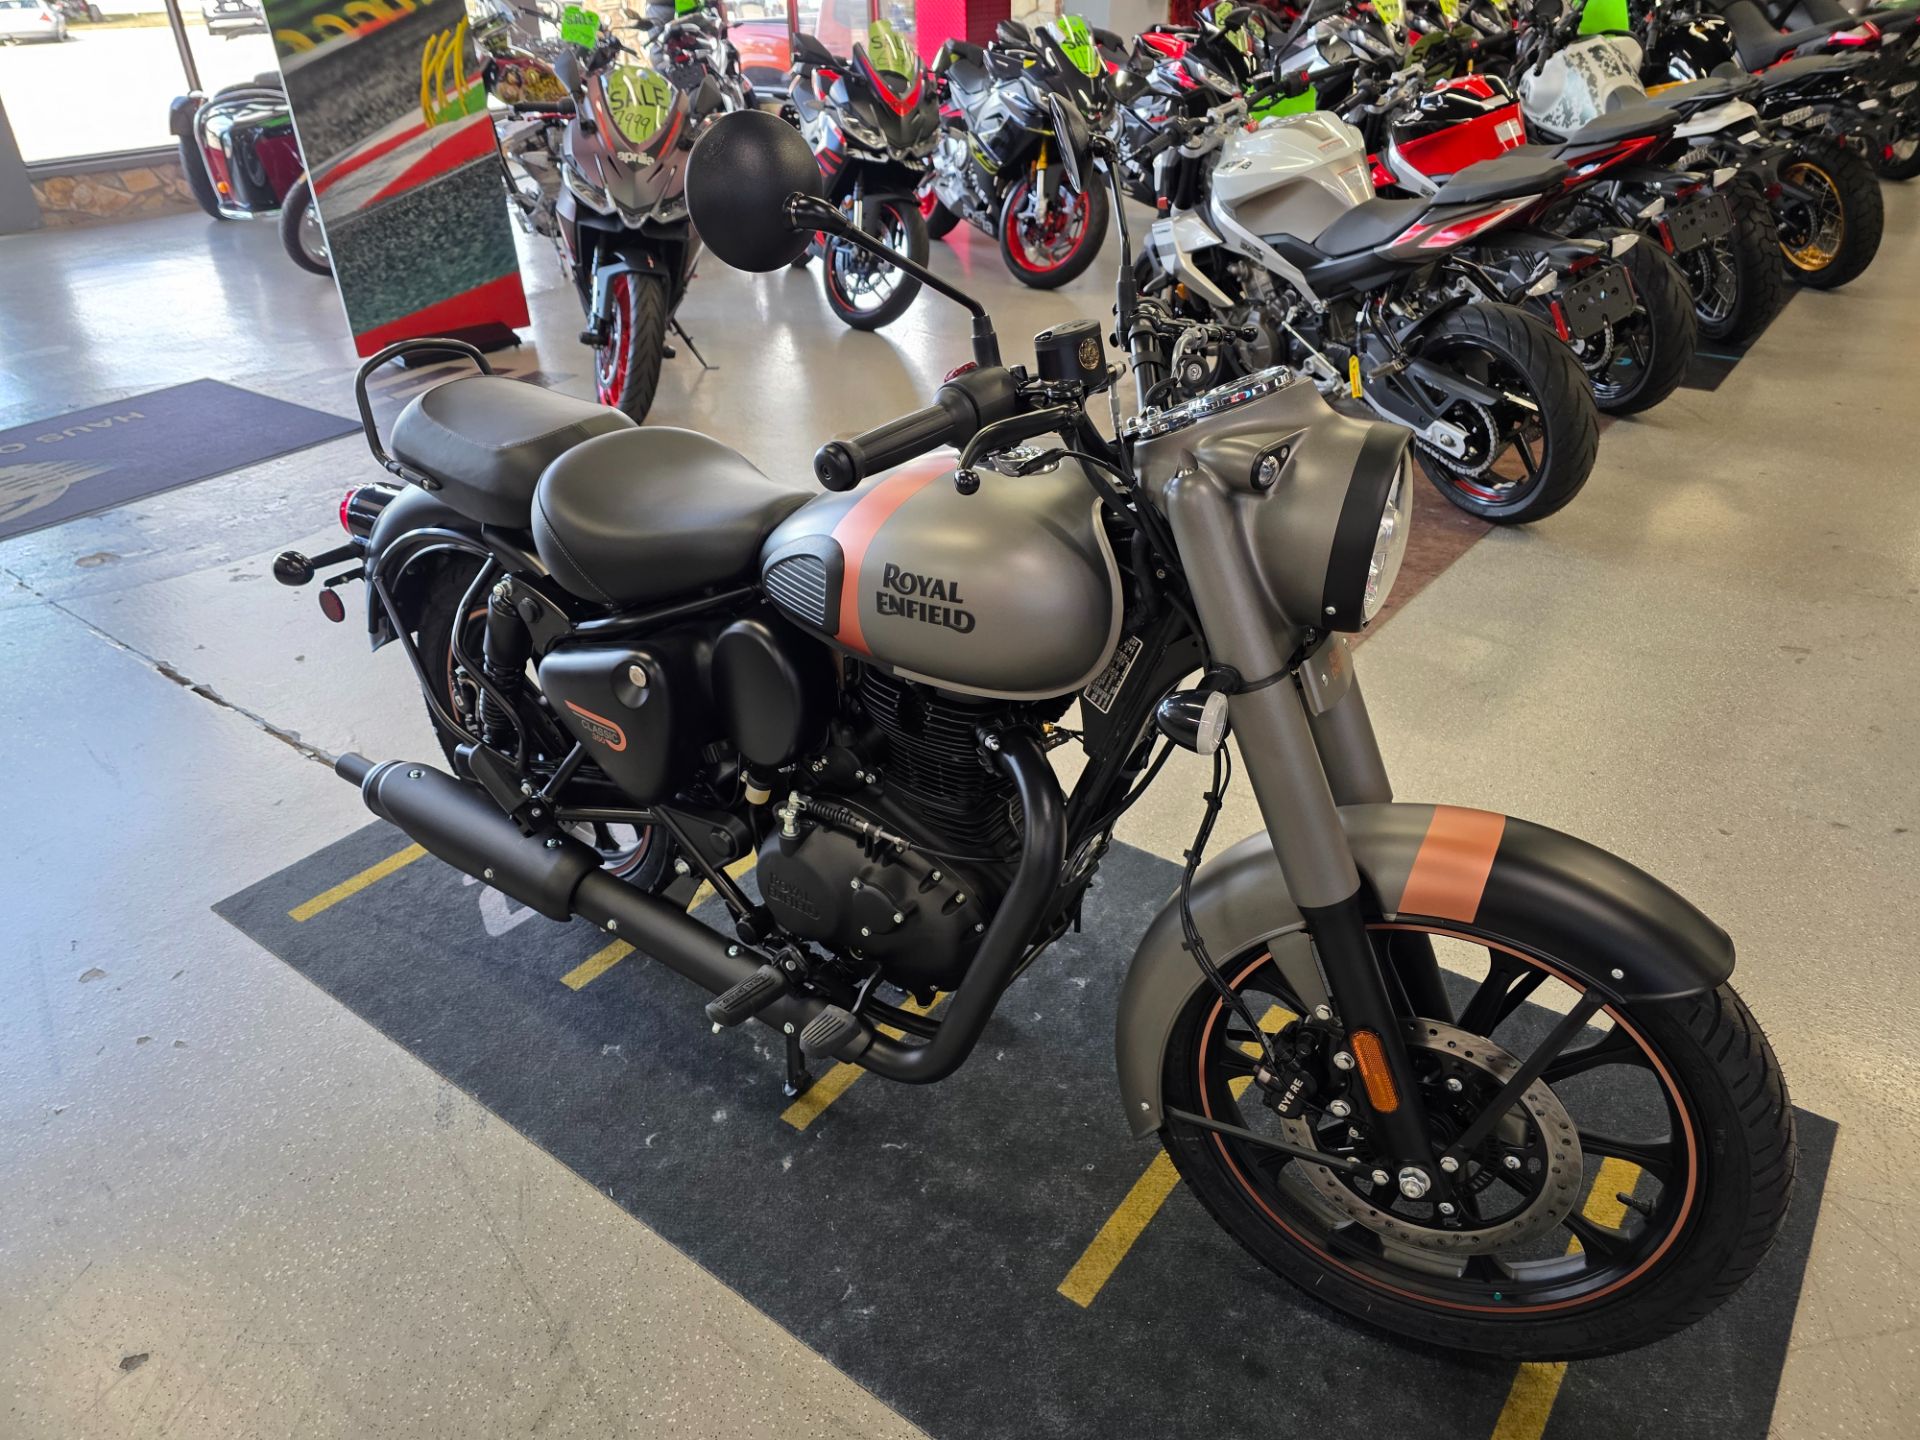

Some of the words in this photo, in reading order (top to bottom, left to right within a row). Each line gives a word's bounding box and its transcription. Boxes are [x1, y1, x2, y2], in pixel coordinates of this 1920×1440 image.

[610, 84, 668, 110] SALE
[617, 151, 655, 166] aprilia
[36, 411, 145, 444] HAUS
[882, 562, 964, 604] ROYAL
[876, 591, 976, 634] ENFIELD
